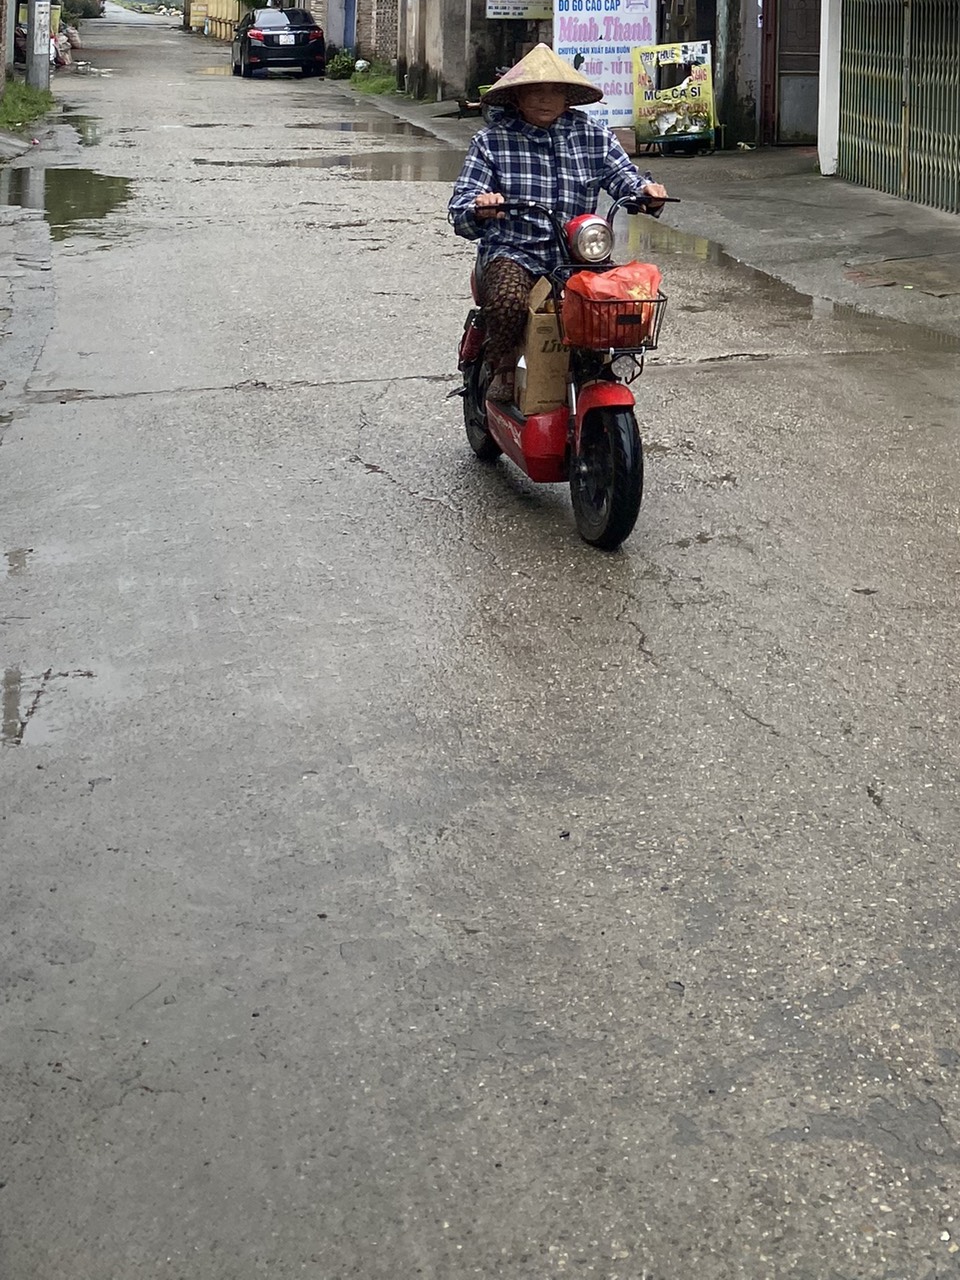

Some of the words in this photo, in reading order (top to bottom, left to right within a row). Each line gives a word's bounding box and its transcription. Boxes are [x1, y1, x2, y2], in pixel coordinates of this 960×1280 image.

[585, 0, 602, 12] CAO
[603, 15, 653, 42] Thanh
[644, 89, 661, 101] MC
[671, 88, 687, 99] CA
